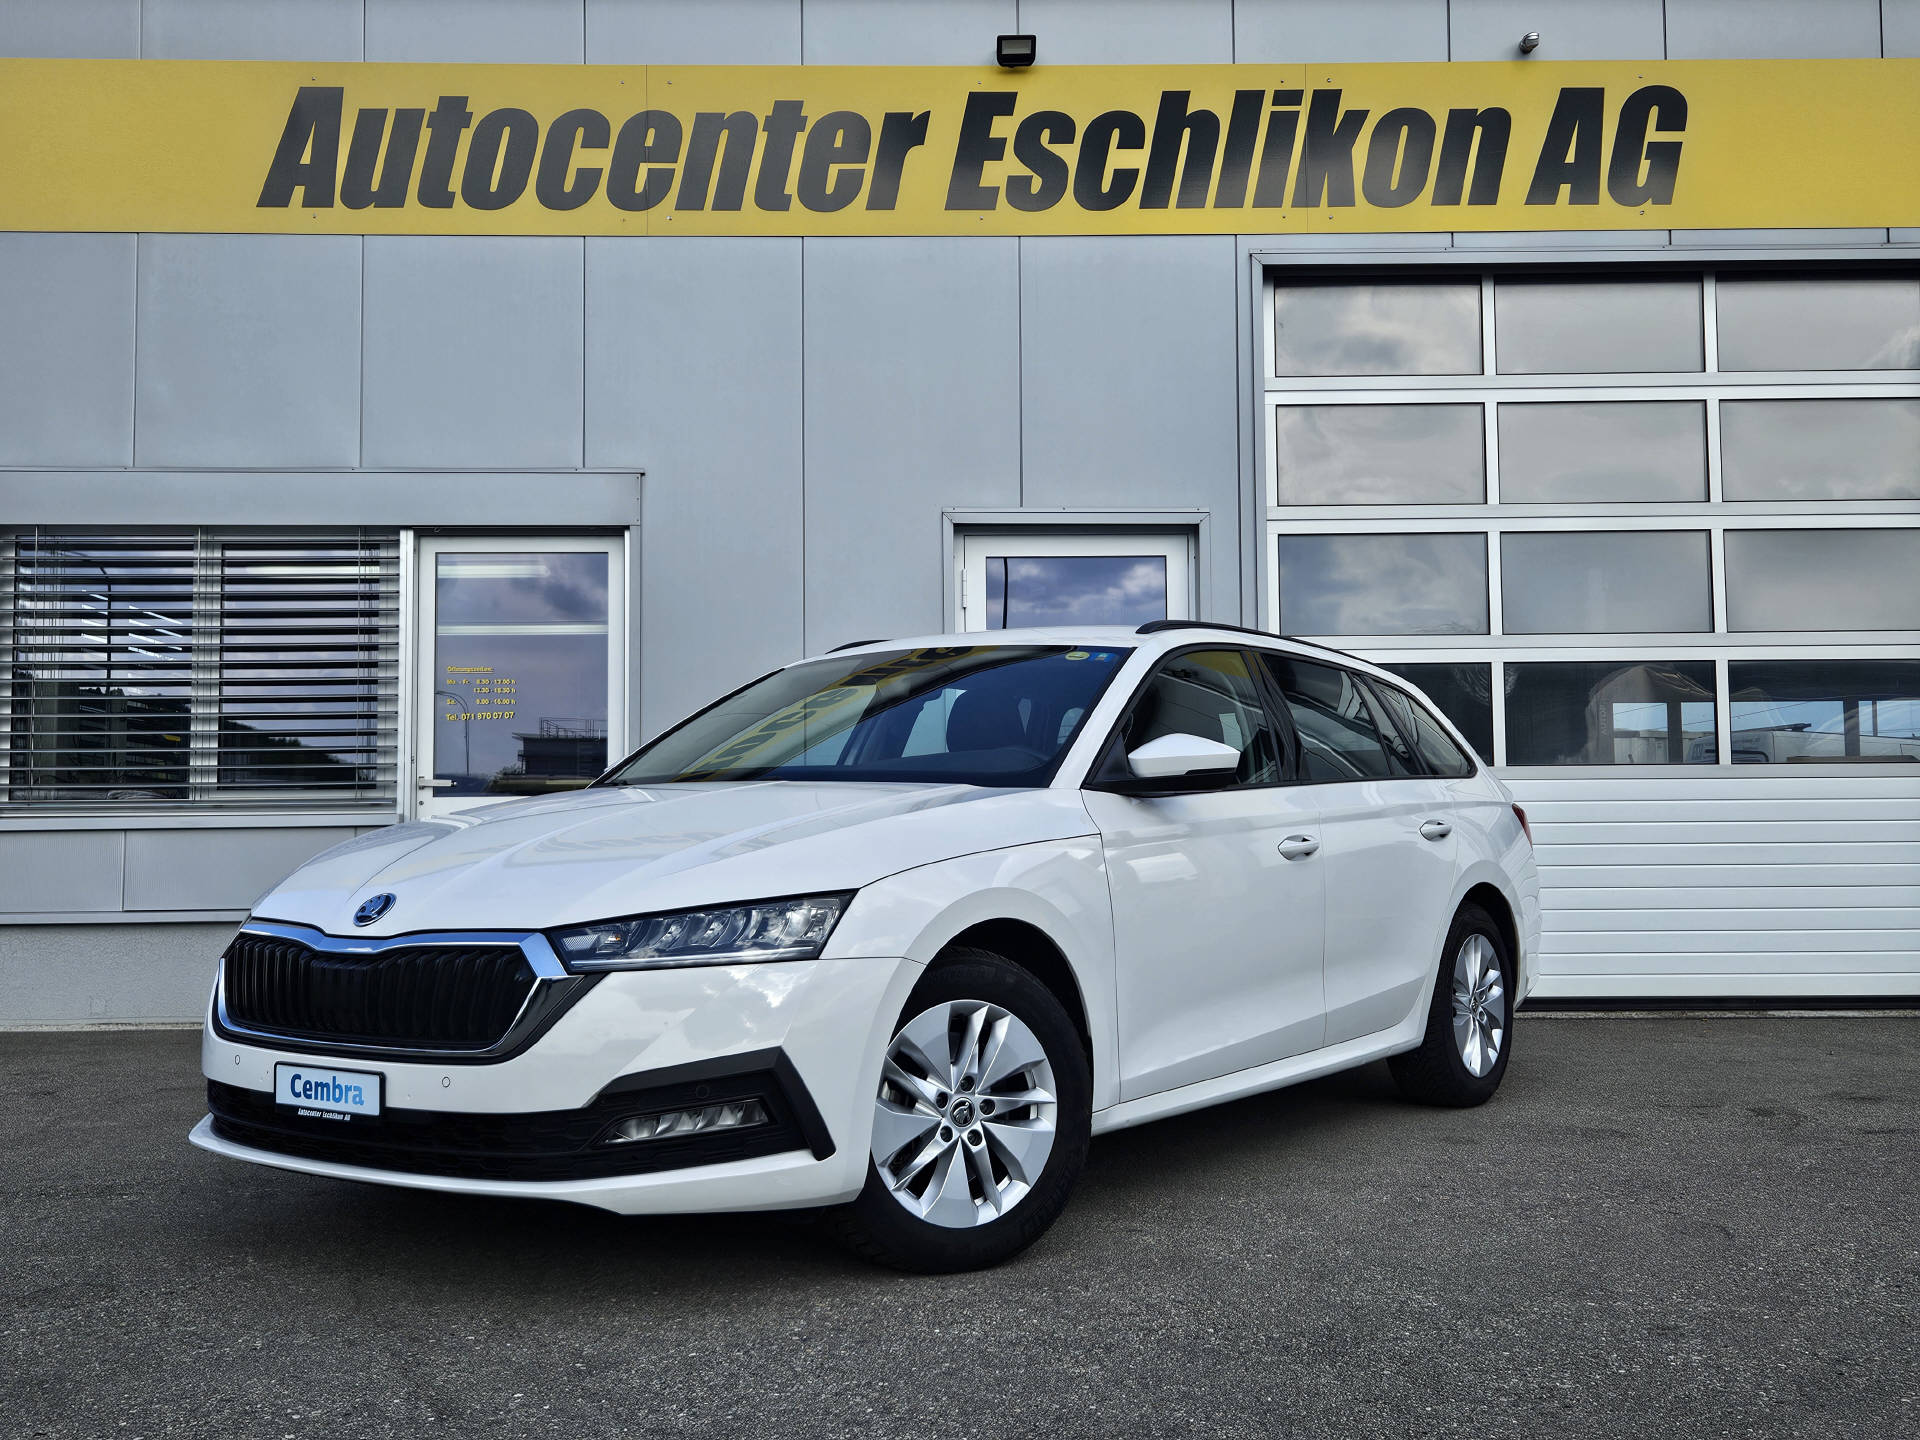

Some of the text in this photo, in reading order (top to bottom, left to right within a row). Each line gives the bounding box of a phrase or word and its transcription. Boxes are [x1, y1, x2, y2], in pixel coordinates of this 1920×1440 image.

[256, 85, 1688, 212] Autocenter Eschlikon AG
[504, 711, 515, 719] 07
[290, 1073, 364, 1106] Cembra
[298, 1108, 322, 1117] Autocenter
[322, 1111, 344, 1120] Eschlikon
